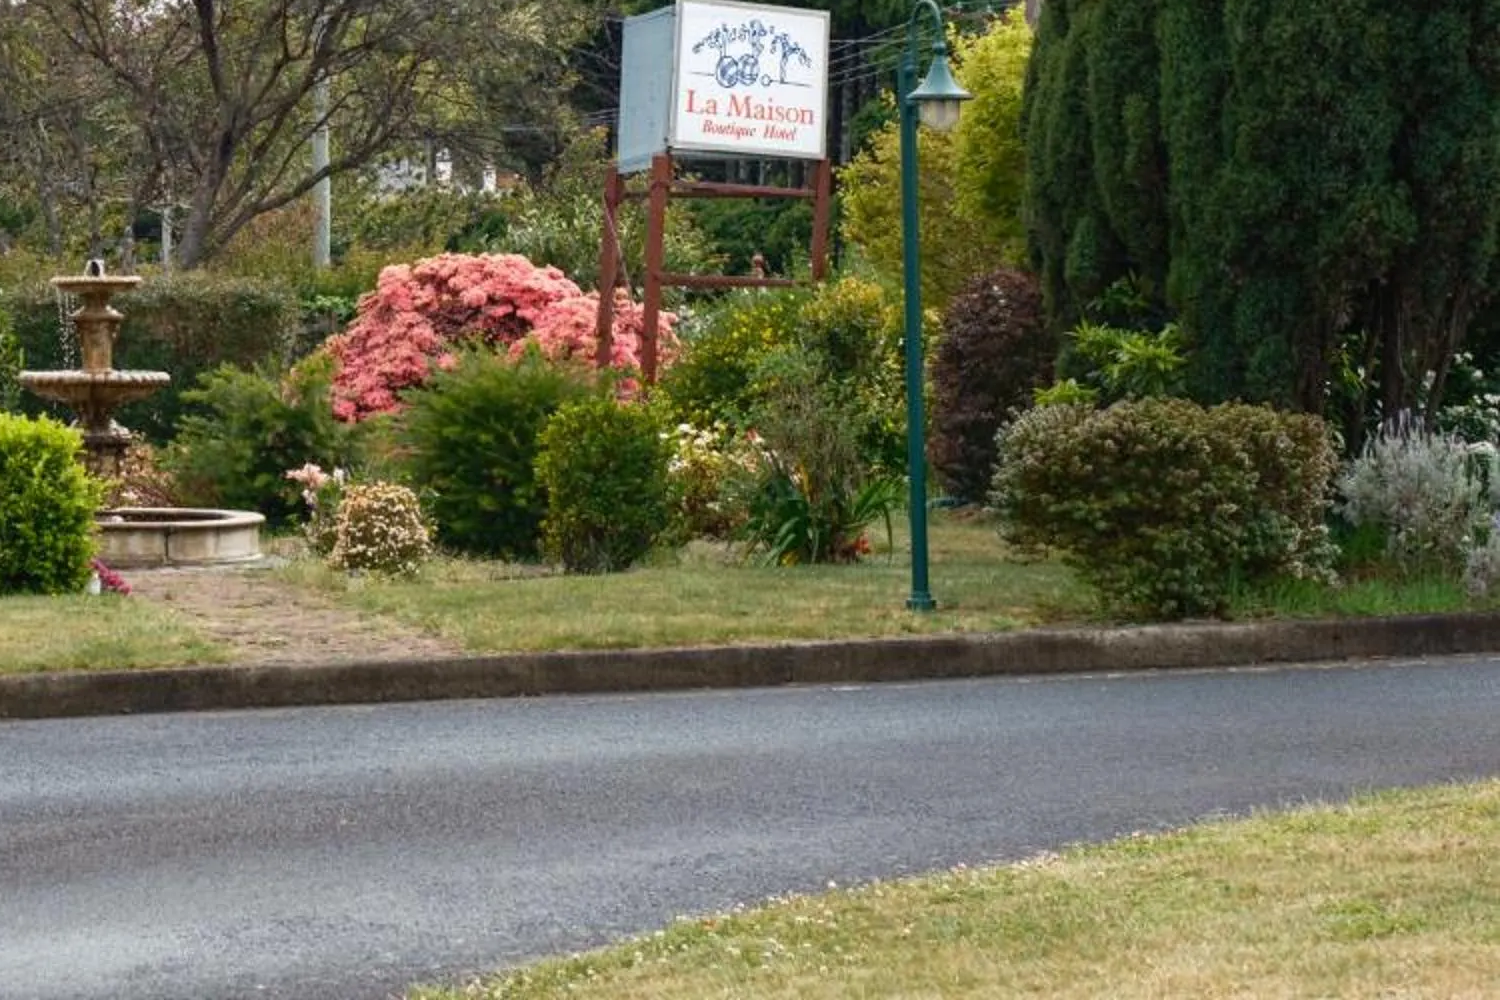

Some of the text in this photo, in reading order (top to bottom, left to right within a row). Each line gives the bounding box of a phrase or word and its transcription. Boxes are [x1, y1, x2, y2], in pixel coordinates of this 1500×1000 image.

[685, 88, 814, 125] La Maison
[702, 119, 797, 141] Boutique Hotel
